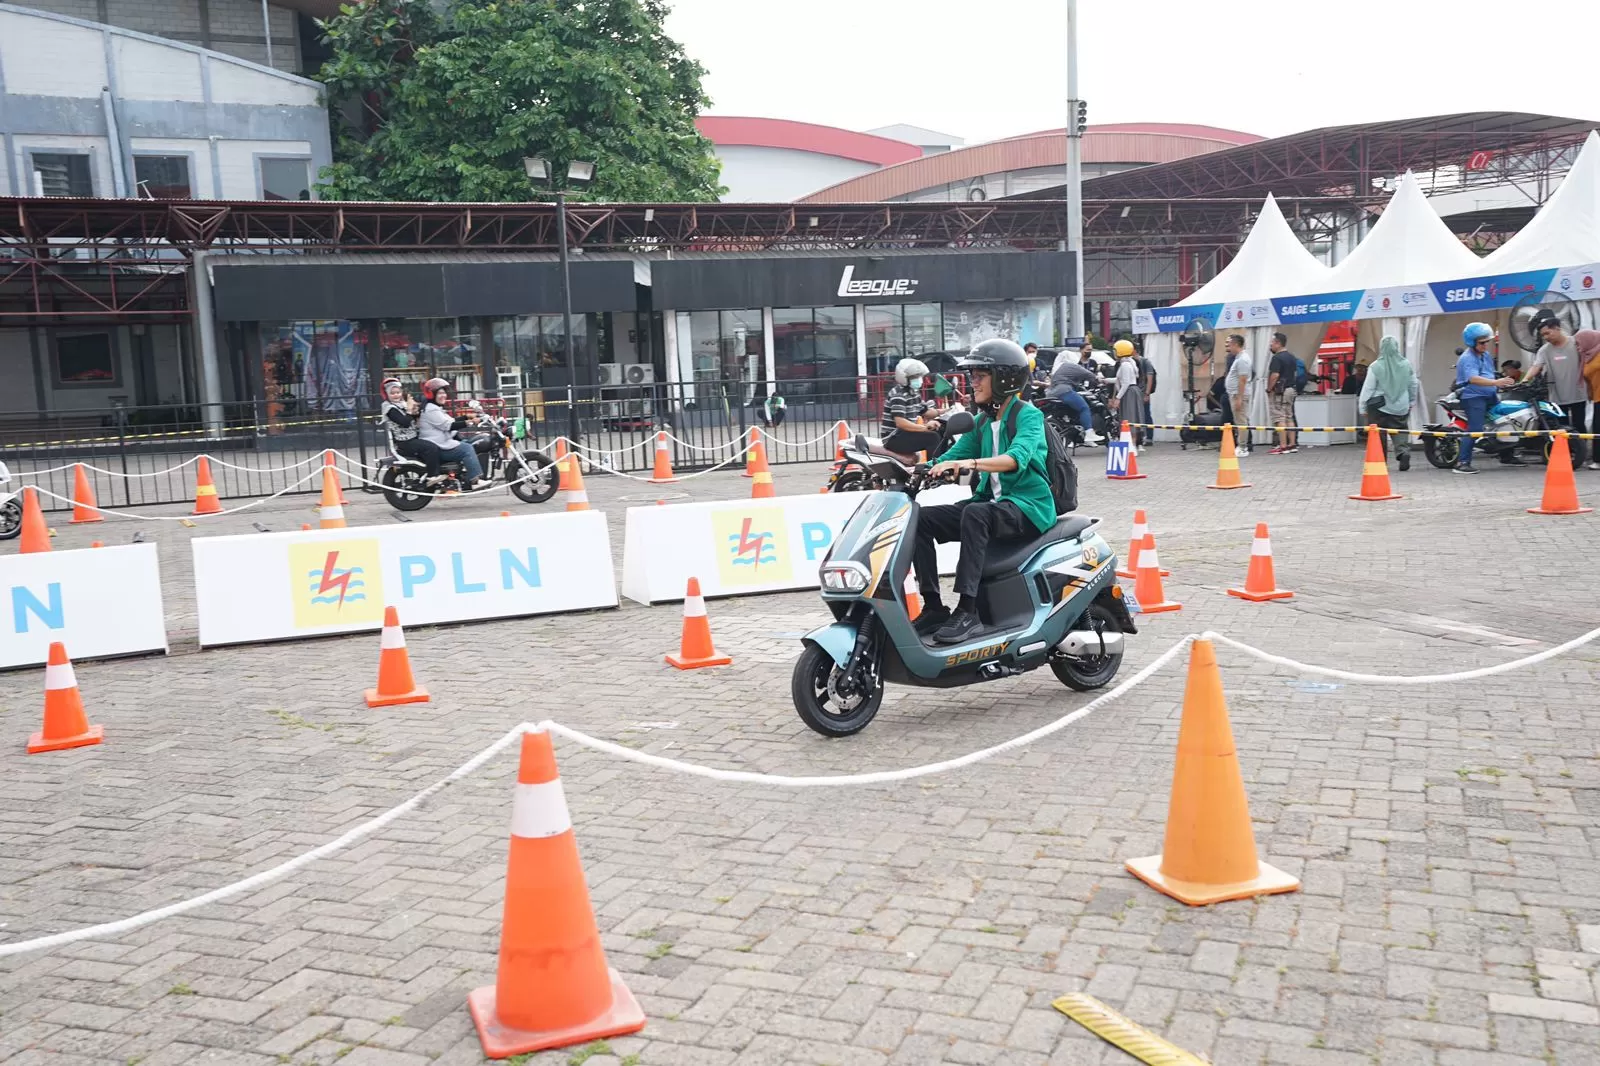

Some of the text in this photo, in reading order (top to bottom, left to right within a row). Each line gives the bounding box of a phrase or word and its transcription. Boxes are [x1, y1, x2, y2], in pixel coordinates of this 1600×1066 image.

[837, 265, 909, 297] League
[1446, 287, 1486, 302] SELIS
[1281, 304, 1308, 316] SAIGE
[1107, 446, 1128, 471] IN
[1083, 546, 1098, 562] 03
[400, 547, 541, 598] PLN
[1087, 564, 1111, 591] ELECTRO
[945, 641, 1009, 667] SPORTY
